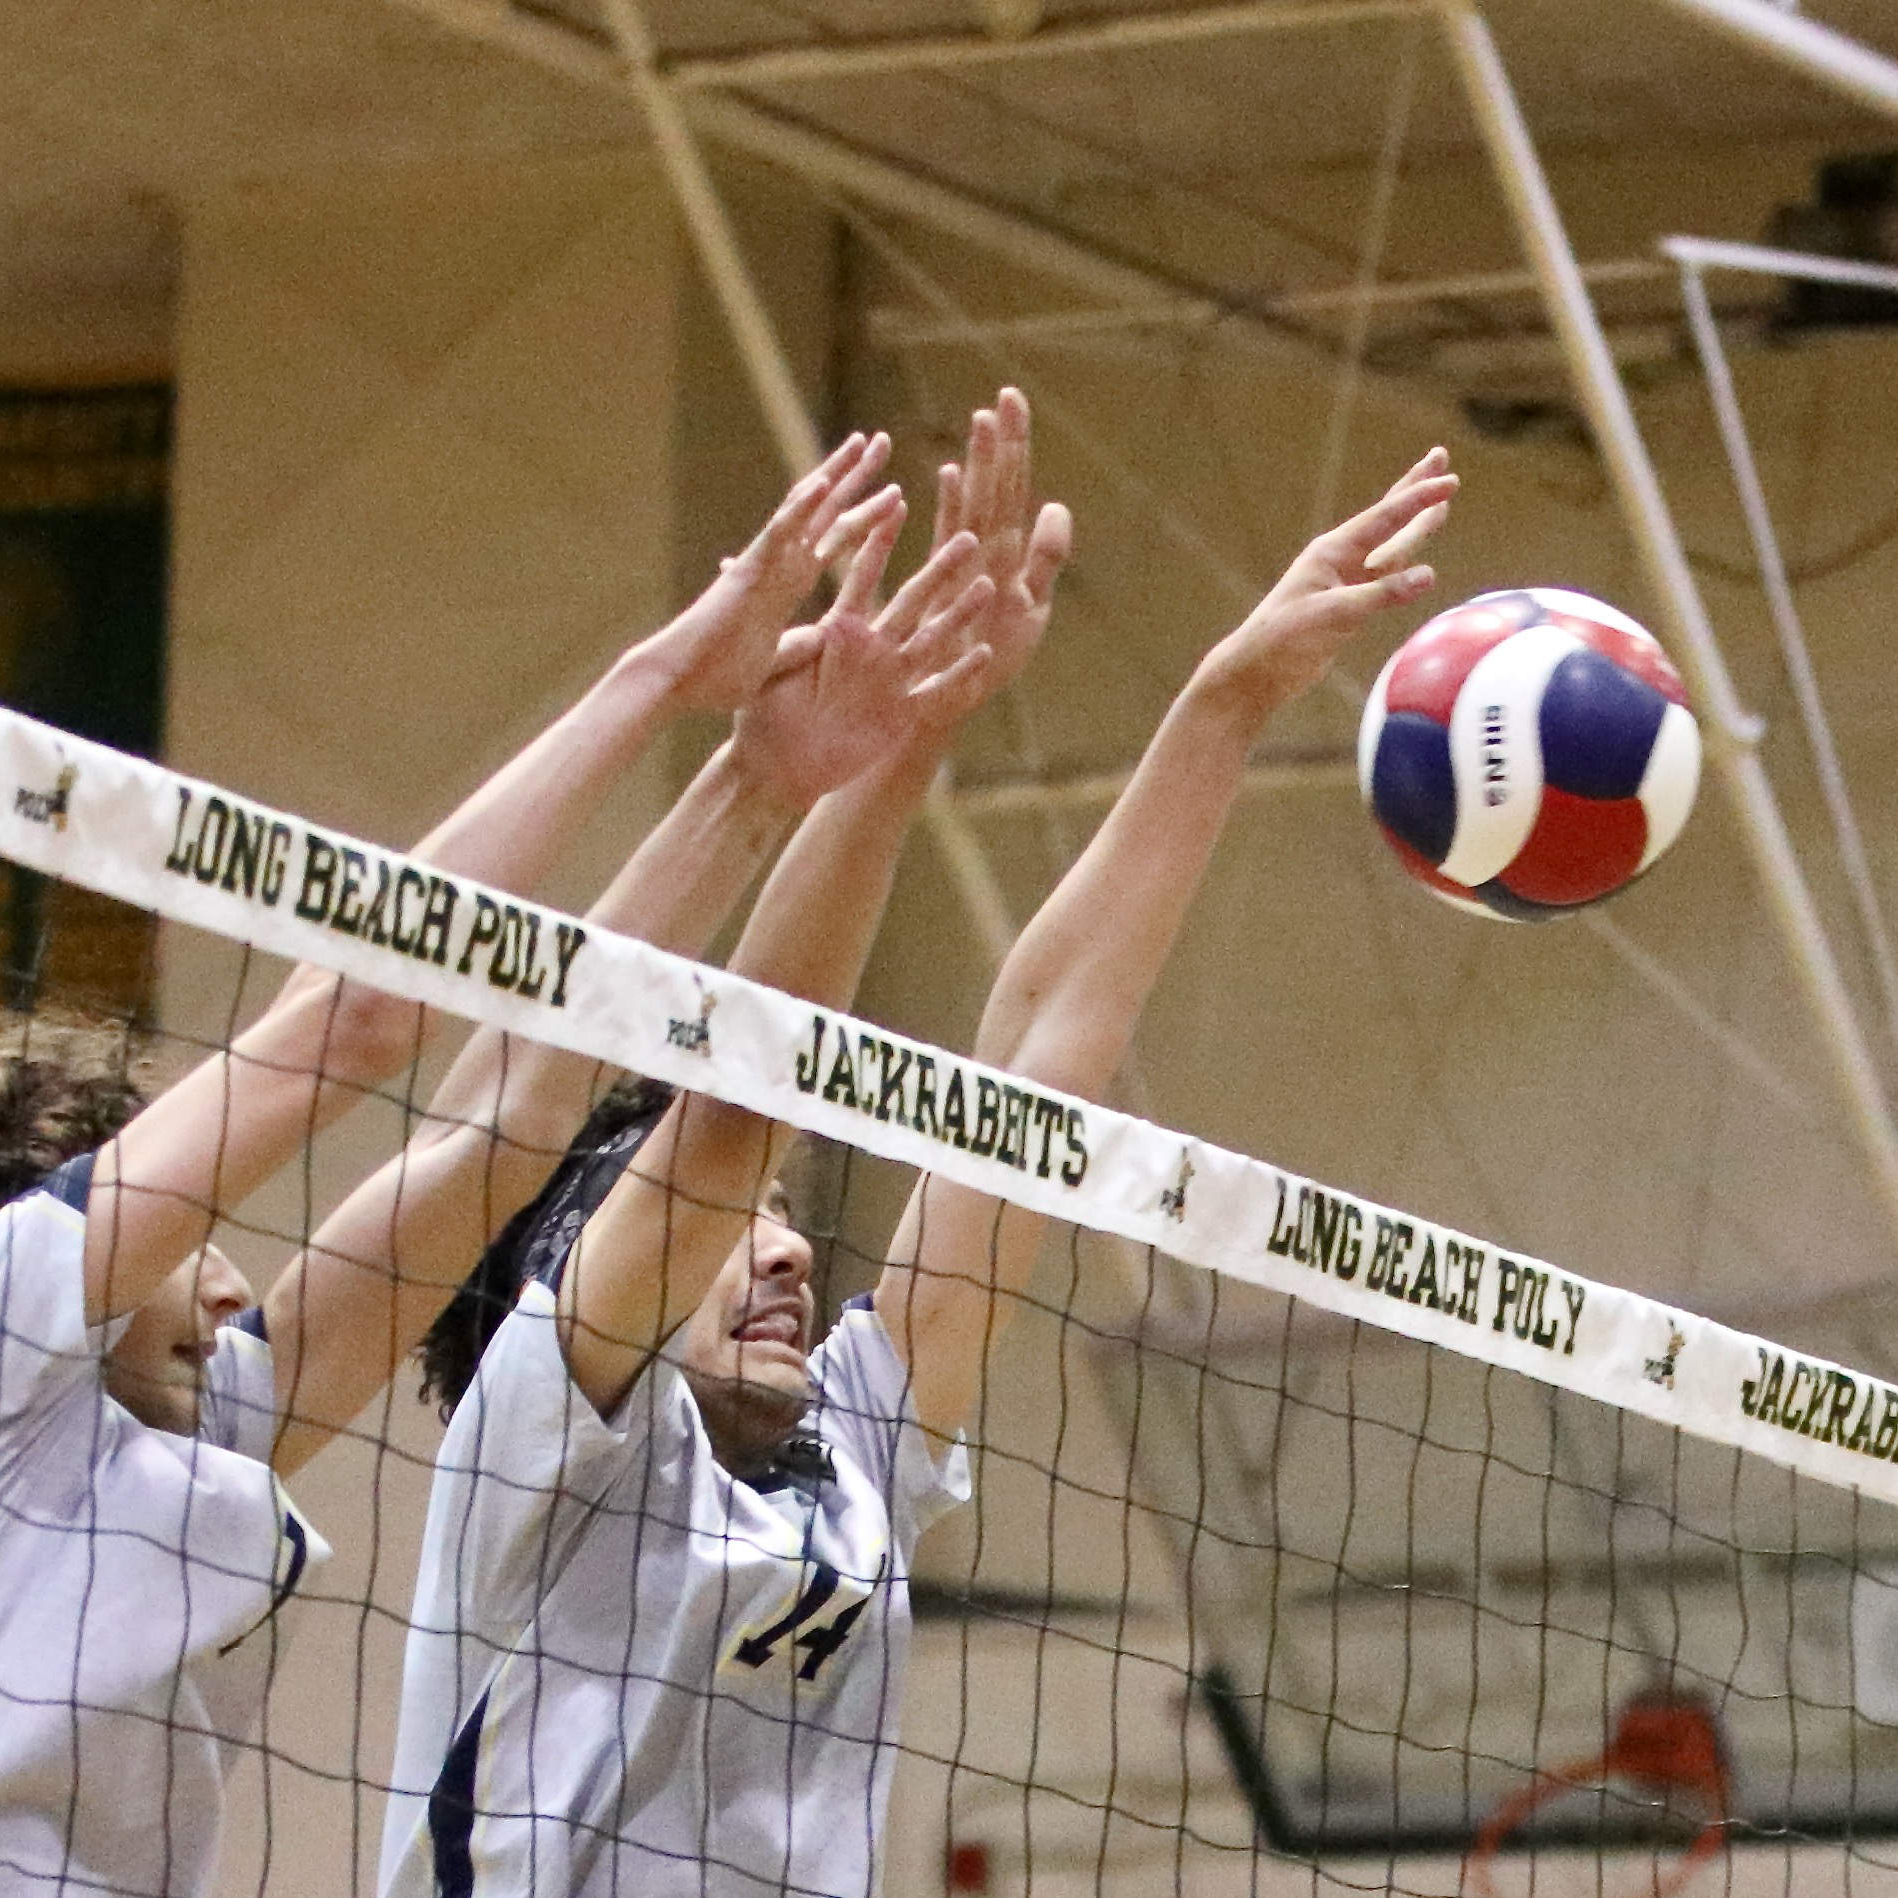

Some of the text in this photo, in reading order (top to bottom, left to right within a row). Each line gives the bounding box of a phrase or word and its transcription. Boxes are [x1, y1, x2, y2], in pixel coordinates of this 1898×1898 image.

[165, 787, 586, 1007] LONG BEACH POLY
[797, 1016, 1088, 1186] JACKRABBITS
[1267, 1176, 1585, 1354] LONG BEACH POLY
[733, 1552, 886, 1681] 14
